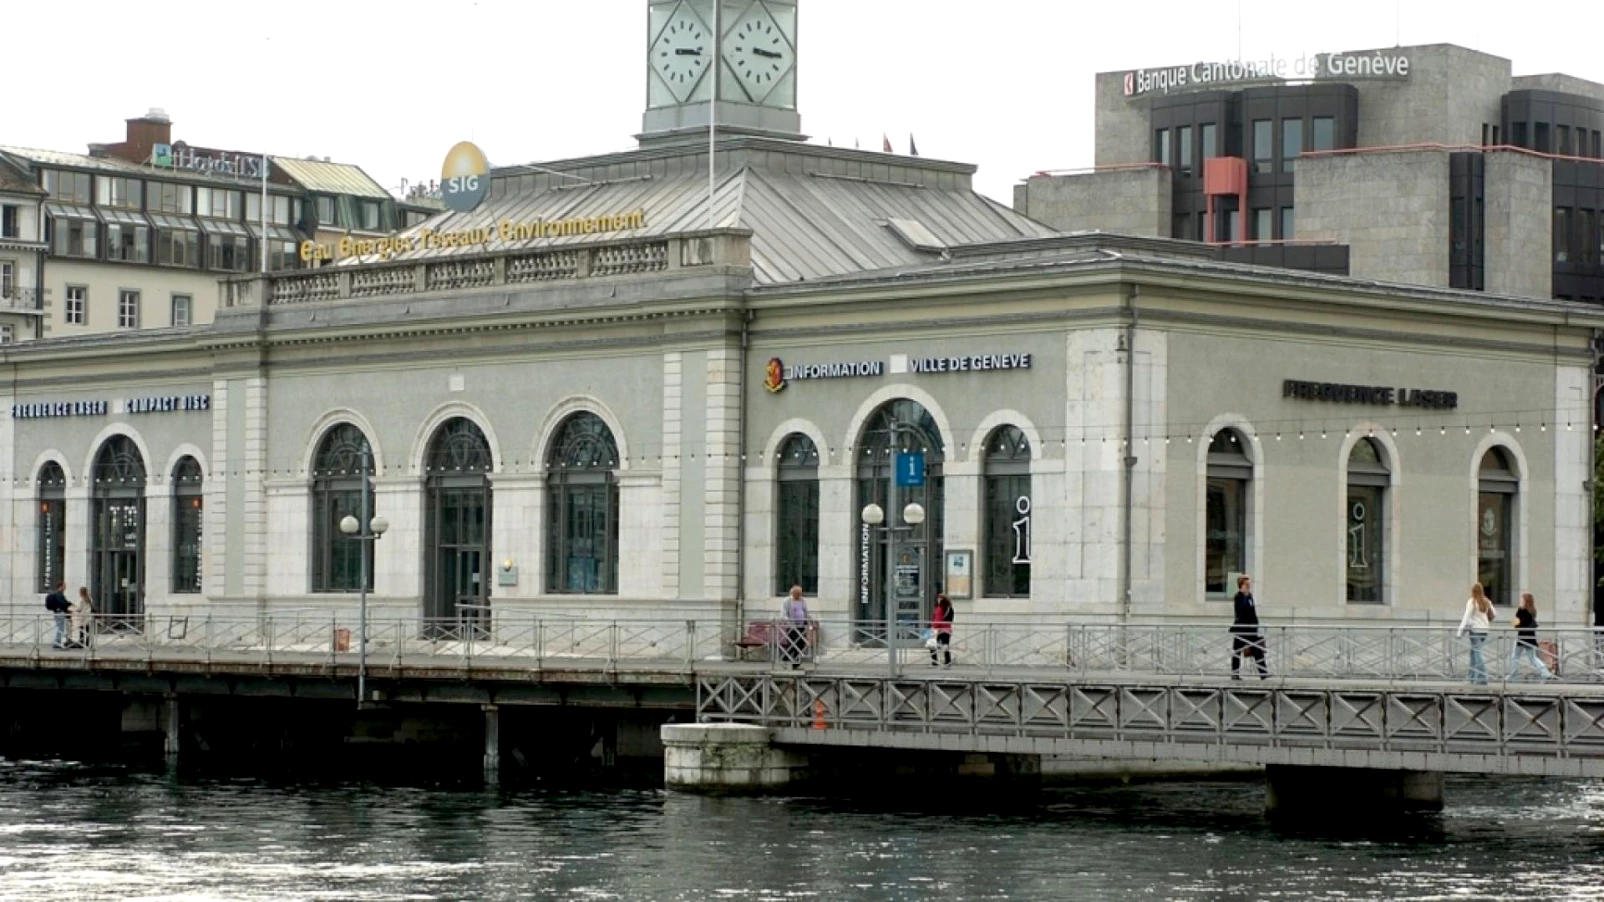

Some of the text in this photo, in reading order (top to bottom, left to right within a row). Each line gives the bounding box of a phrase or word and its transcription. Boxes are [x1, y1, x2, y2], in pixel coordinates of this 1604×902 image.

[1136, 50, 1409, 94] Banque Cantonale de Genève
[448, 176, 479, 194] SIG
[792, 361, 884, 380] INFORMATION
[909, 355, 946, 373] VILLE
[949, 355, 970, 372] DE
[73, 400, 107, 416] LASER
[125, 394, 210, 413] COMPACT DISC
[861, 523, 870, 604] INFORMATION
